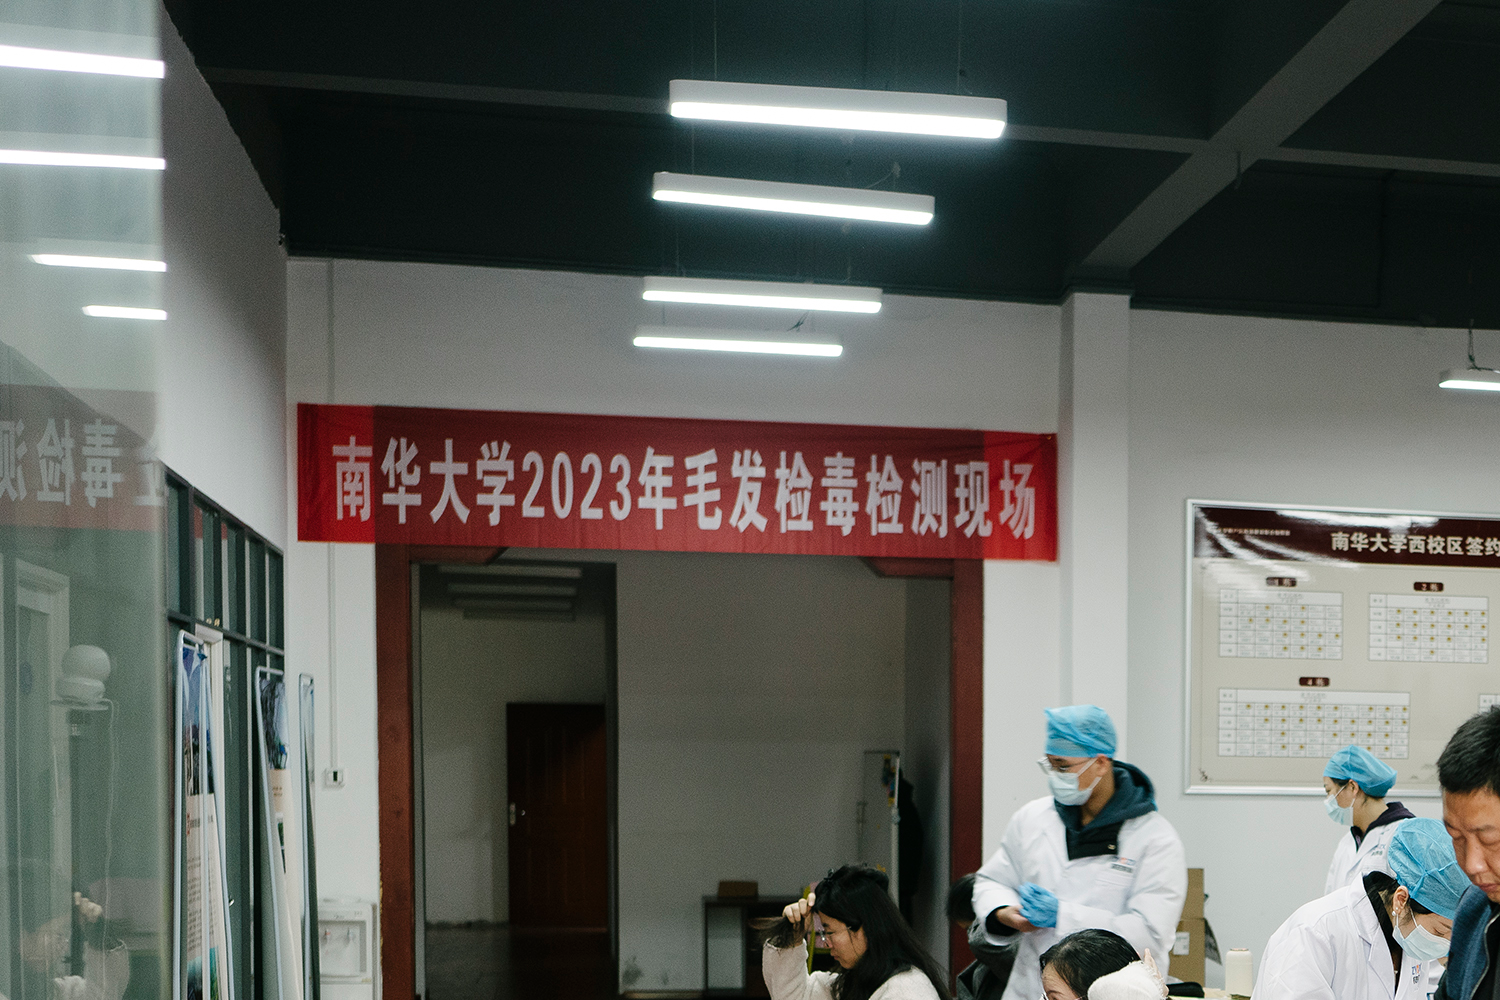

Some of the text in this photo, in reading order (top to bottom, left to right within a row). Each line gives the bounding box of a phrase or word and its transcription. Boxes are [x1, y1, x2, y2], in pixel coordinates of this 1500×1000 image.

[332, 434, 1037, 540] 南华大学2023年毛发检毒检测现场
